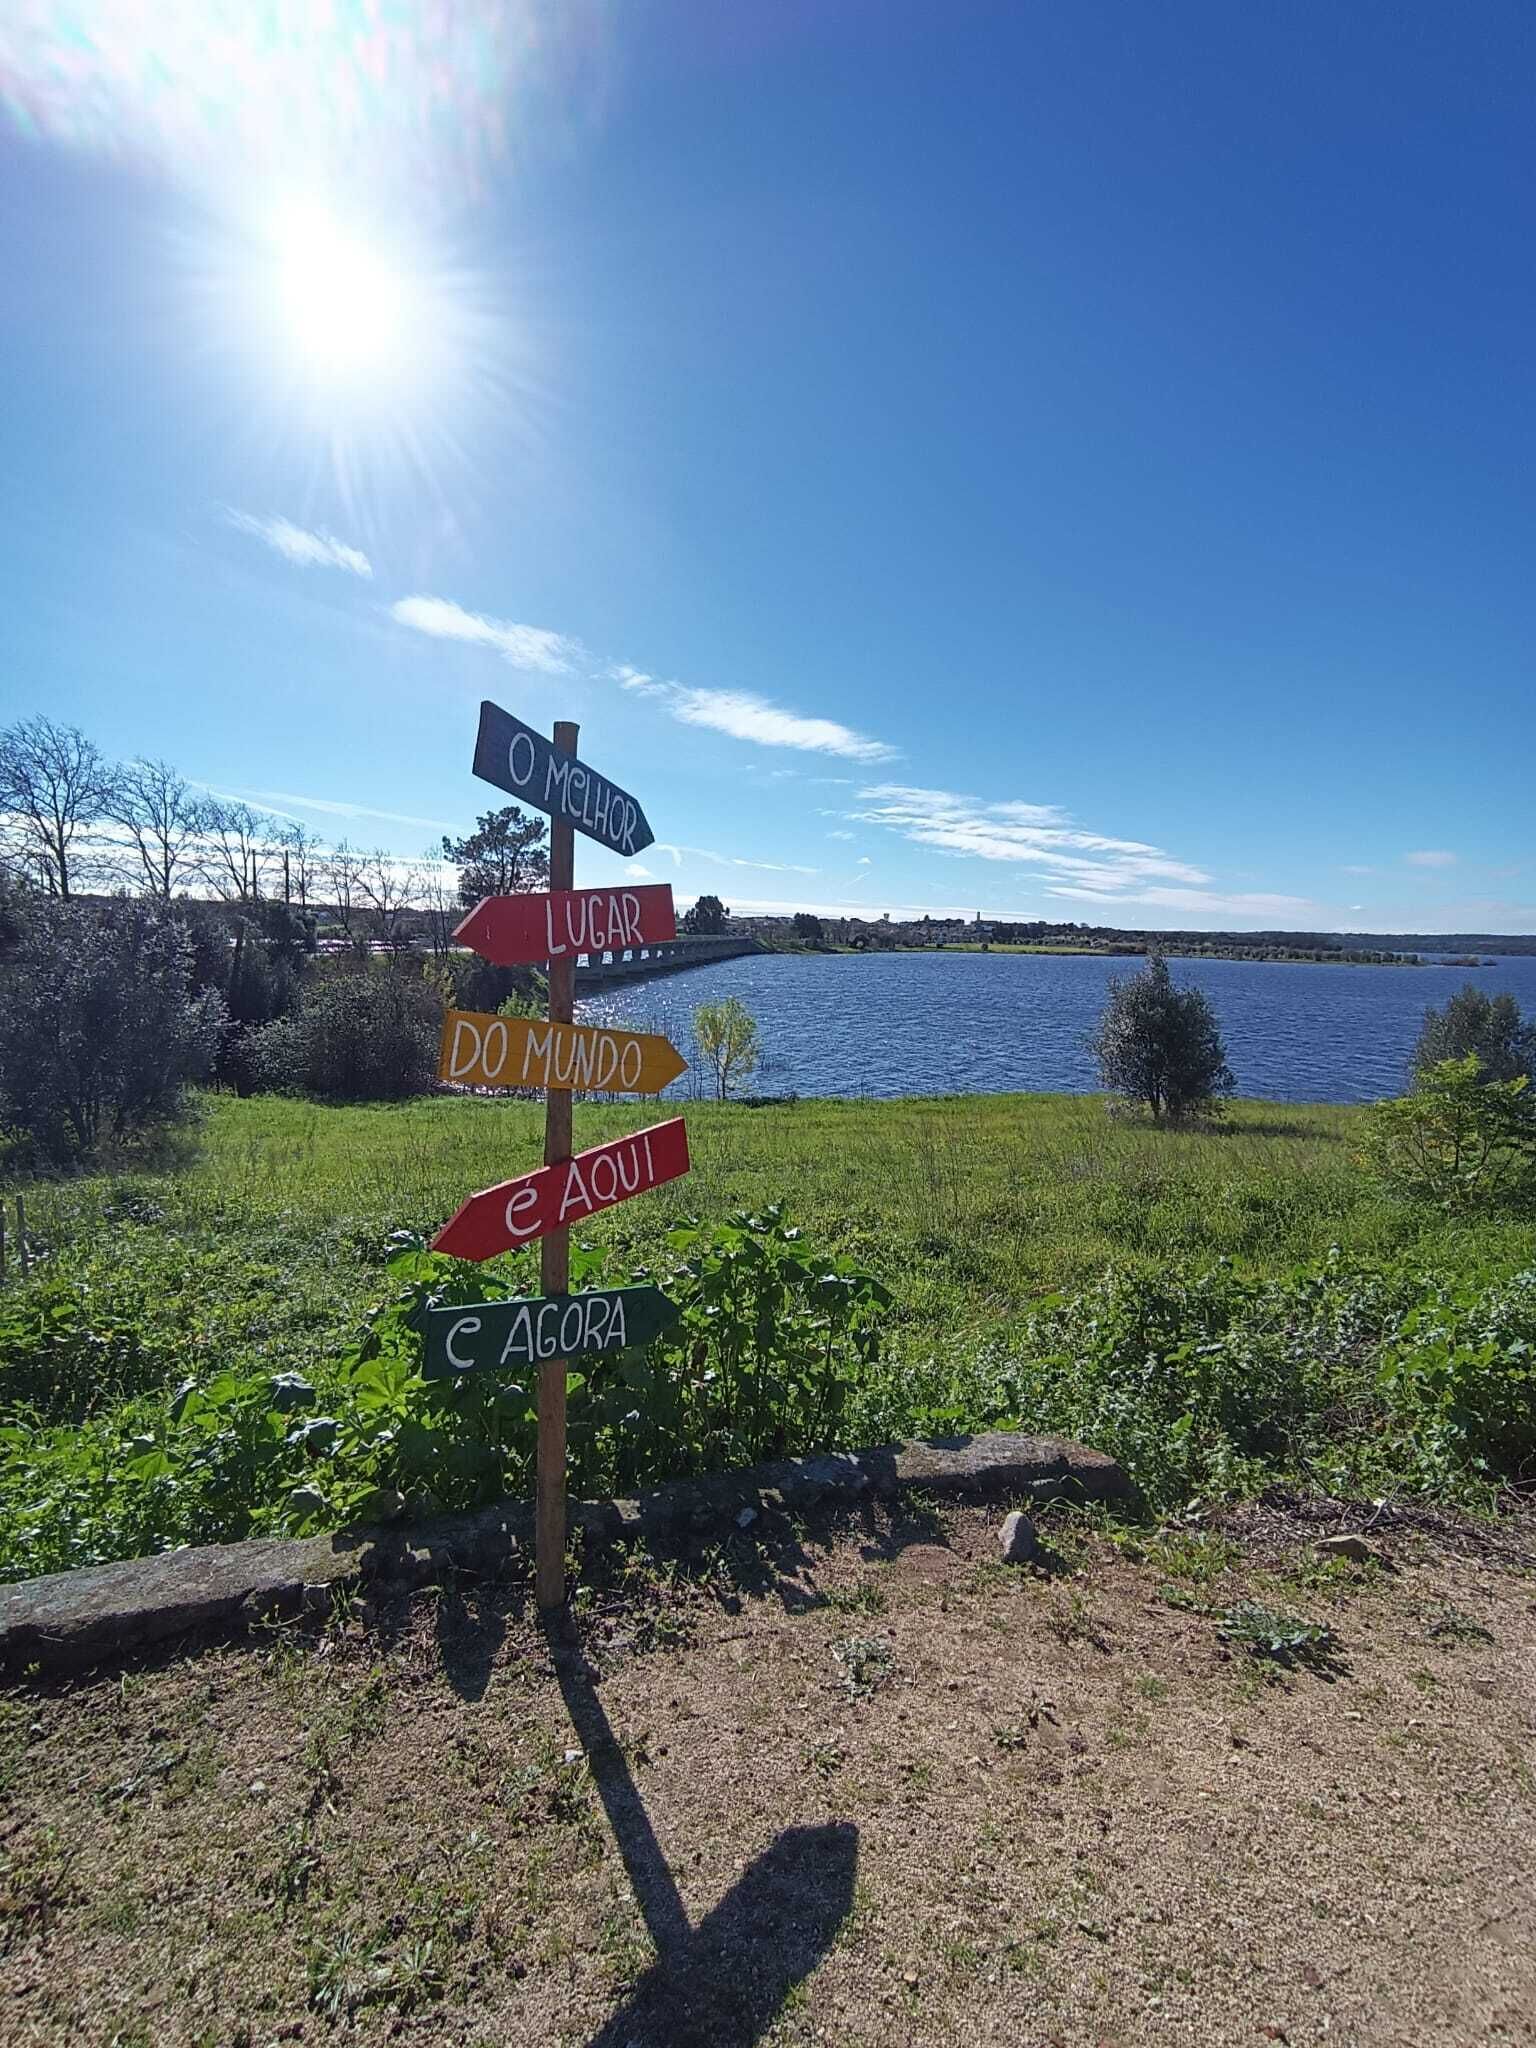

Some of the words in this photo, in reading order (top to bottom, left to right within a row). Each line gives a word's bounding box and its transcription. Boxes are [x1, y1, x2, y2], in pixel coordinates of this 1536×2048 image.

[509, 732, 535, 785] O
[546, 893, 643, 954] LUGAR
[449, 1020, 508, 1078] DO
[522, 1027, 642, 1088] MUNDO
[559, 1136, 655, 1221] AQUI
[500, 1296, 627, 1364] AGORA
